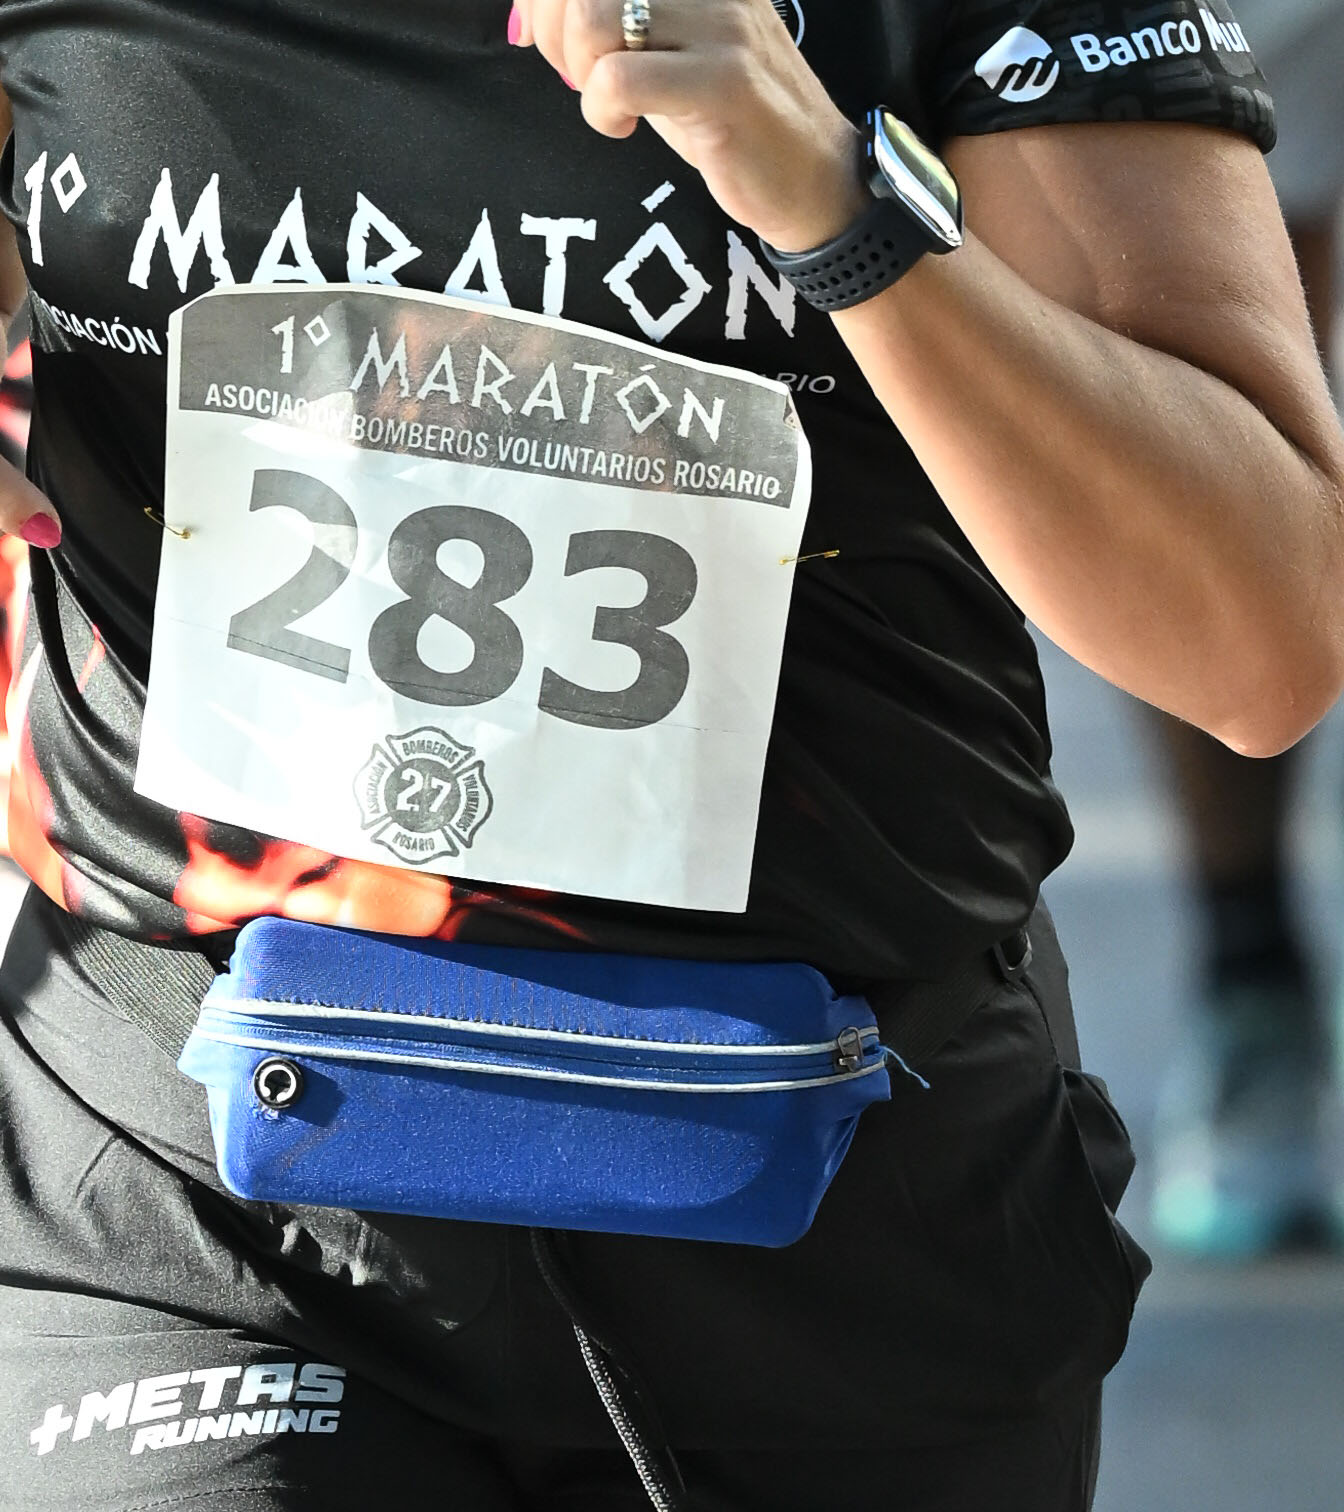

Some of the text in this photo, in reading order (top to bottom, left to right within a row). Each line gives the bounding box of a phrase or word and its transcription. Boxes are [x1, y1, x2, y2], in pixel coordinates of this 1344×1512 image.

[1069, 19, 1202, 73] Banco
[127, 166, 797, 343] MARATÓN
[348, 326, 726, 446] MARATÓN
[350, 412, 489, 460] BOMBEROS
[496, 434, 667, 486] VOLUNTARIOS
[673, 459, 783, 500] ROSARIO
[226, 468, 699, 731] 283
[402, 740, 459, 763] BOMBEROS
[395, 766, 452, 813] 27
[392, 831, 435, 851] ROSARIO
[129, 1408, 341, 1456] RUNNING
